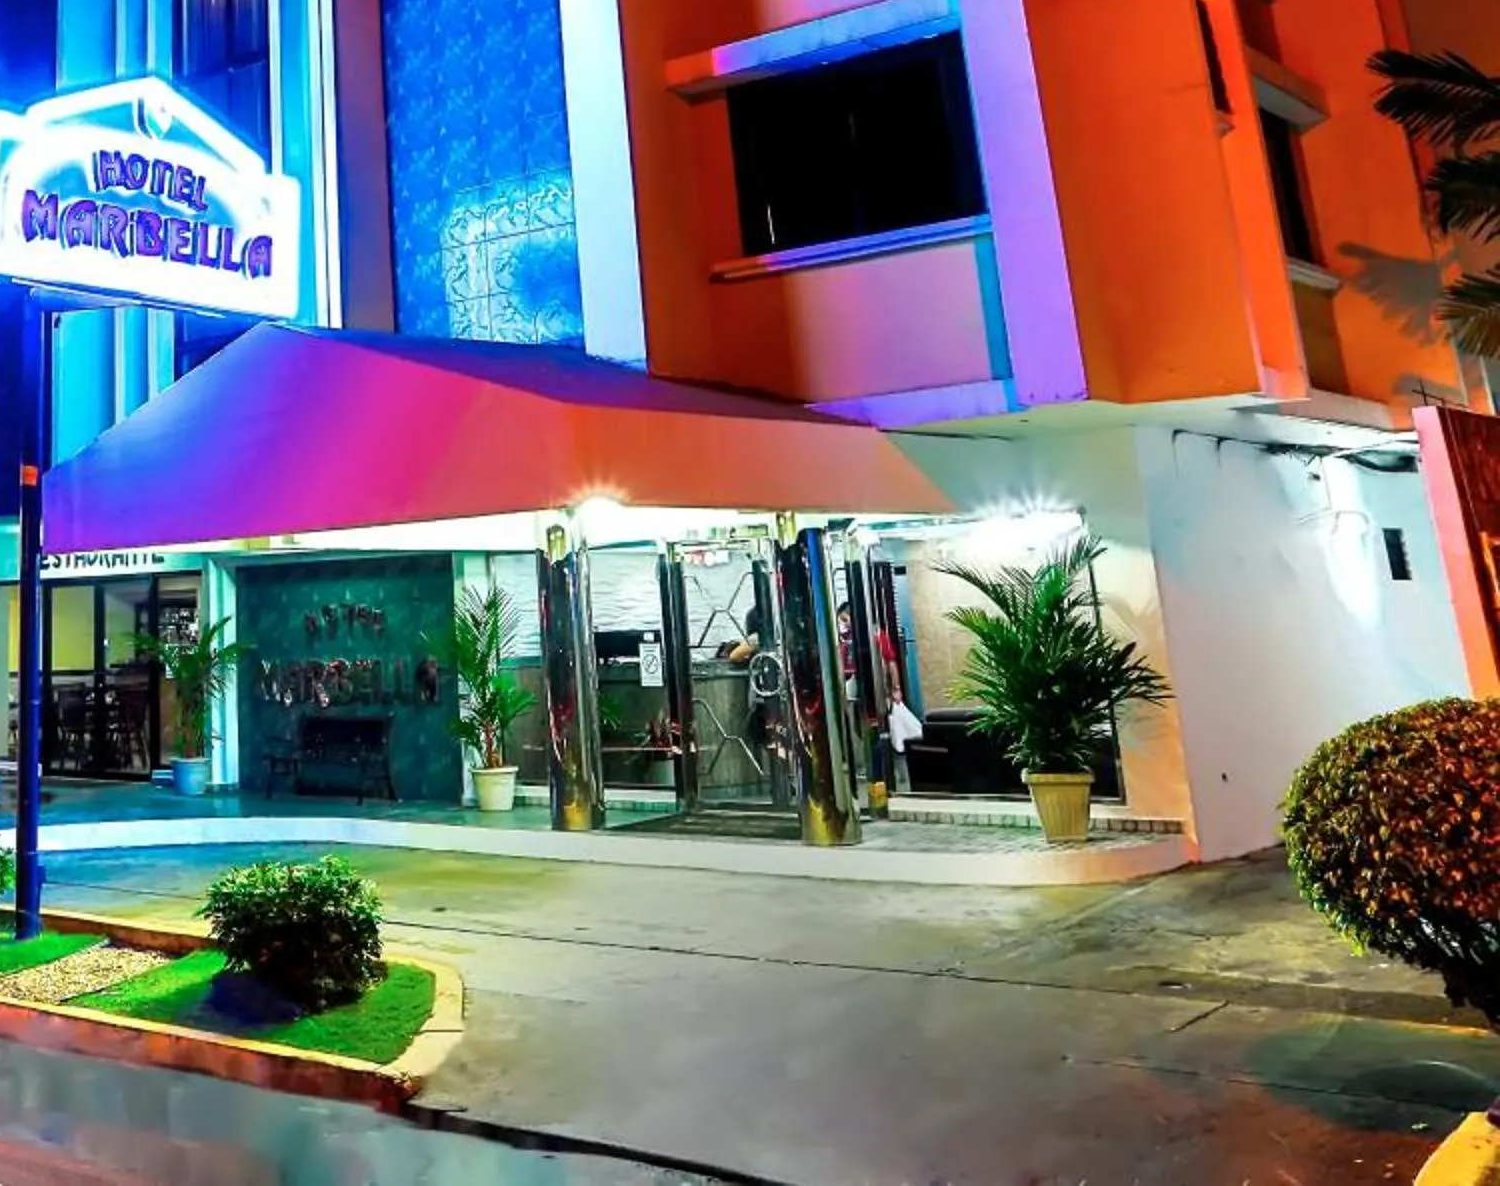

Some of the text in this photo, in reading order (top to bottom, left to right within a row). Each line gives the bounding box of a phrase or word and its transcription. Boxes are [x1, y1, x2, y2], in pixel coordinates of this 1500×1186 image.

[93, 150, 208, 211] HOTEL
[21, 190, 273, 278] MARBELLA
[40, 553, 165, 570] ESTAURANTE
